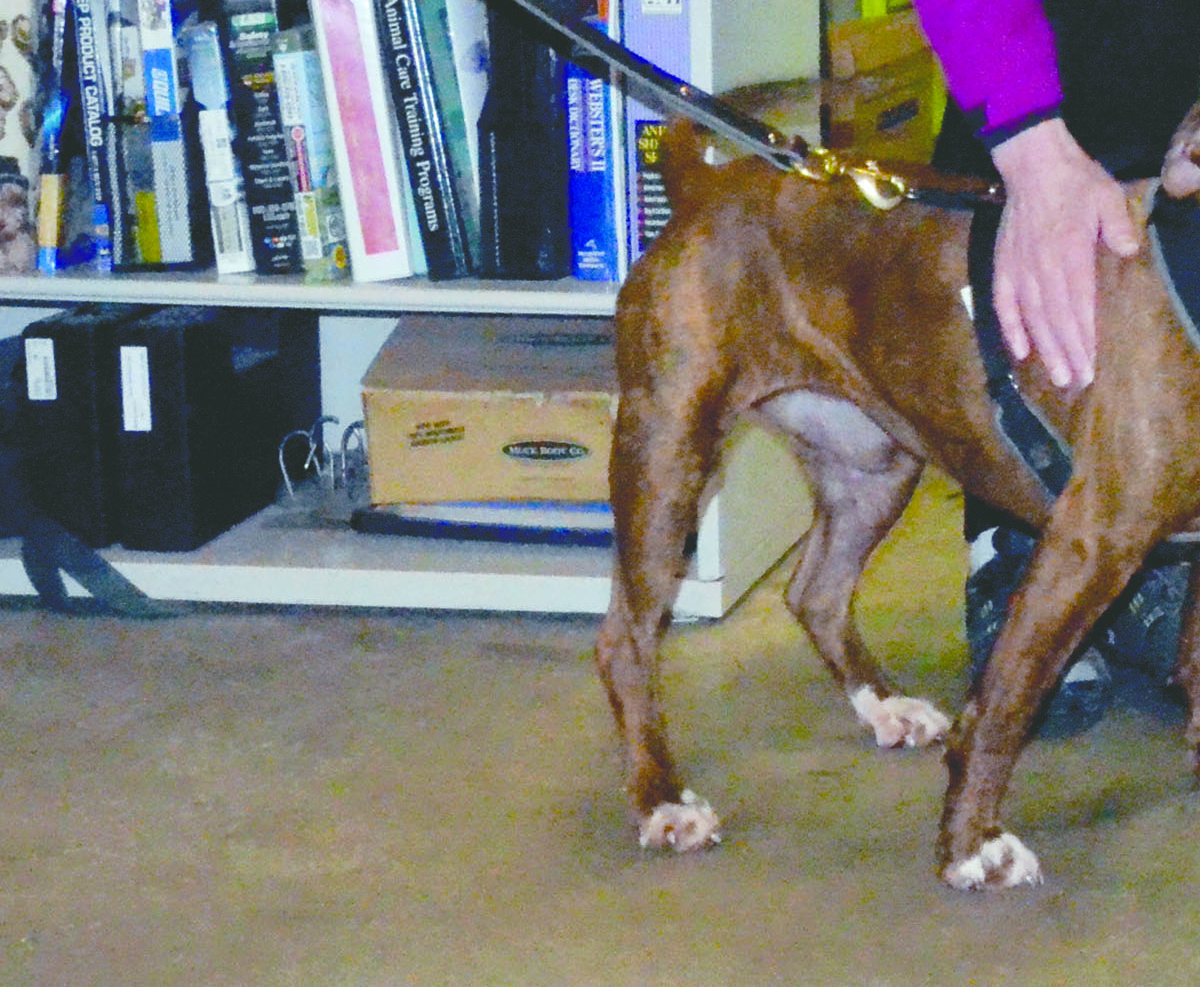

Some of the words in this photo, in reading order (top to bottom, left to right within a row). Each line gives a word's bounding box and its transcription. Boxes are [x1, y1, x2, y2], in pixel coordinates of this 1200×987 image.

[78, 17, 97, 82] PRODUCT
[395, 53, 413, 90] Care
[84, 85, 103, 147] CATALOG
[403, 92, 426, 157] Training
[569, 107, 583, 171] DICTIONARY
[588, 78, 605, 157] WEBSTER'S
[416, 160, 440, 232] Programs
